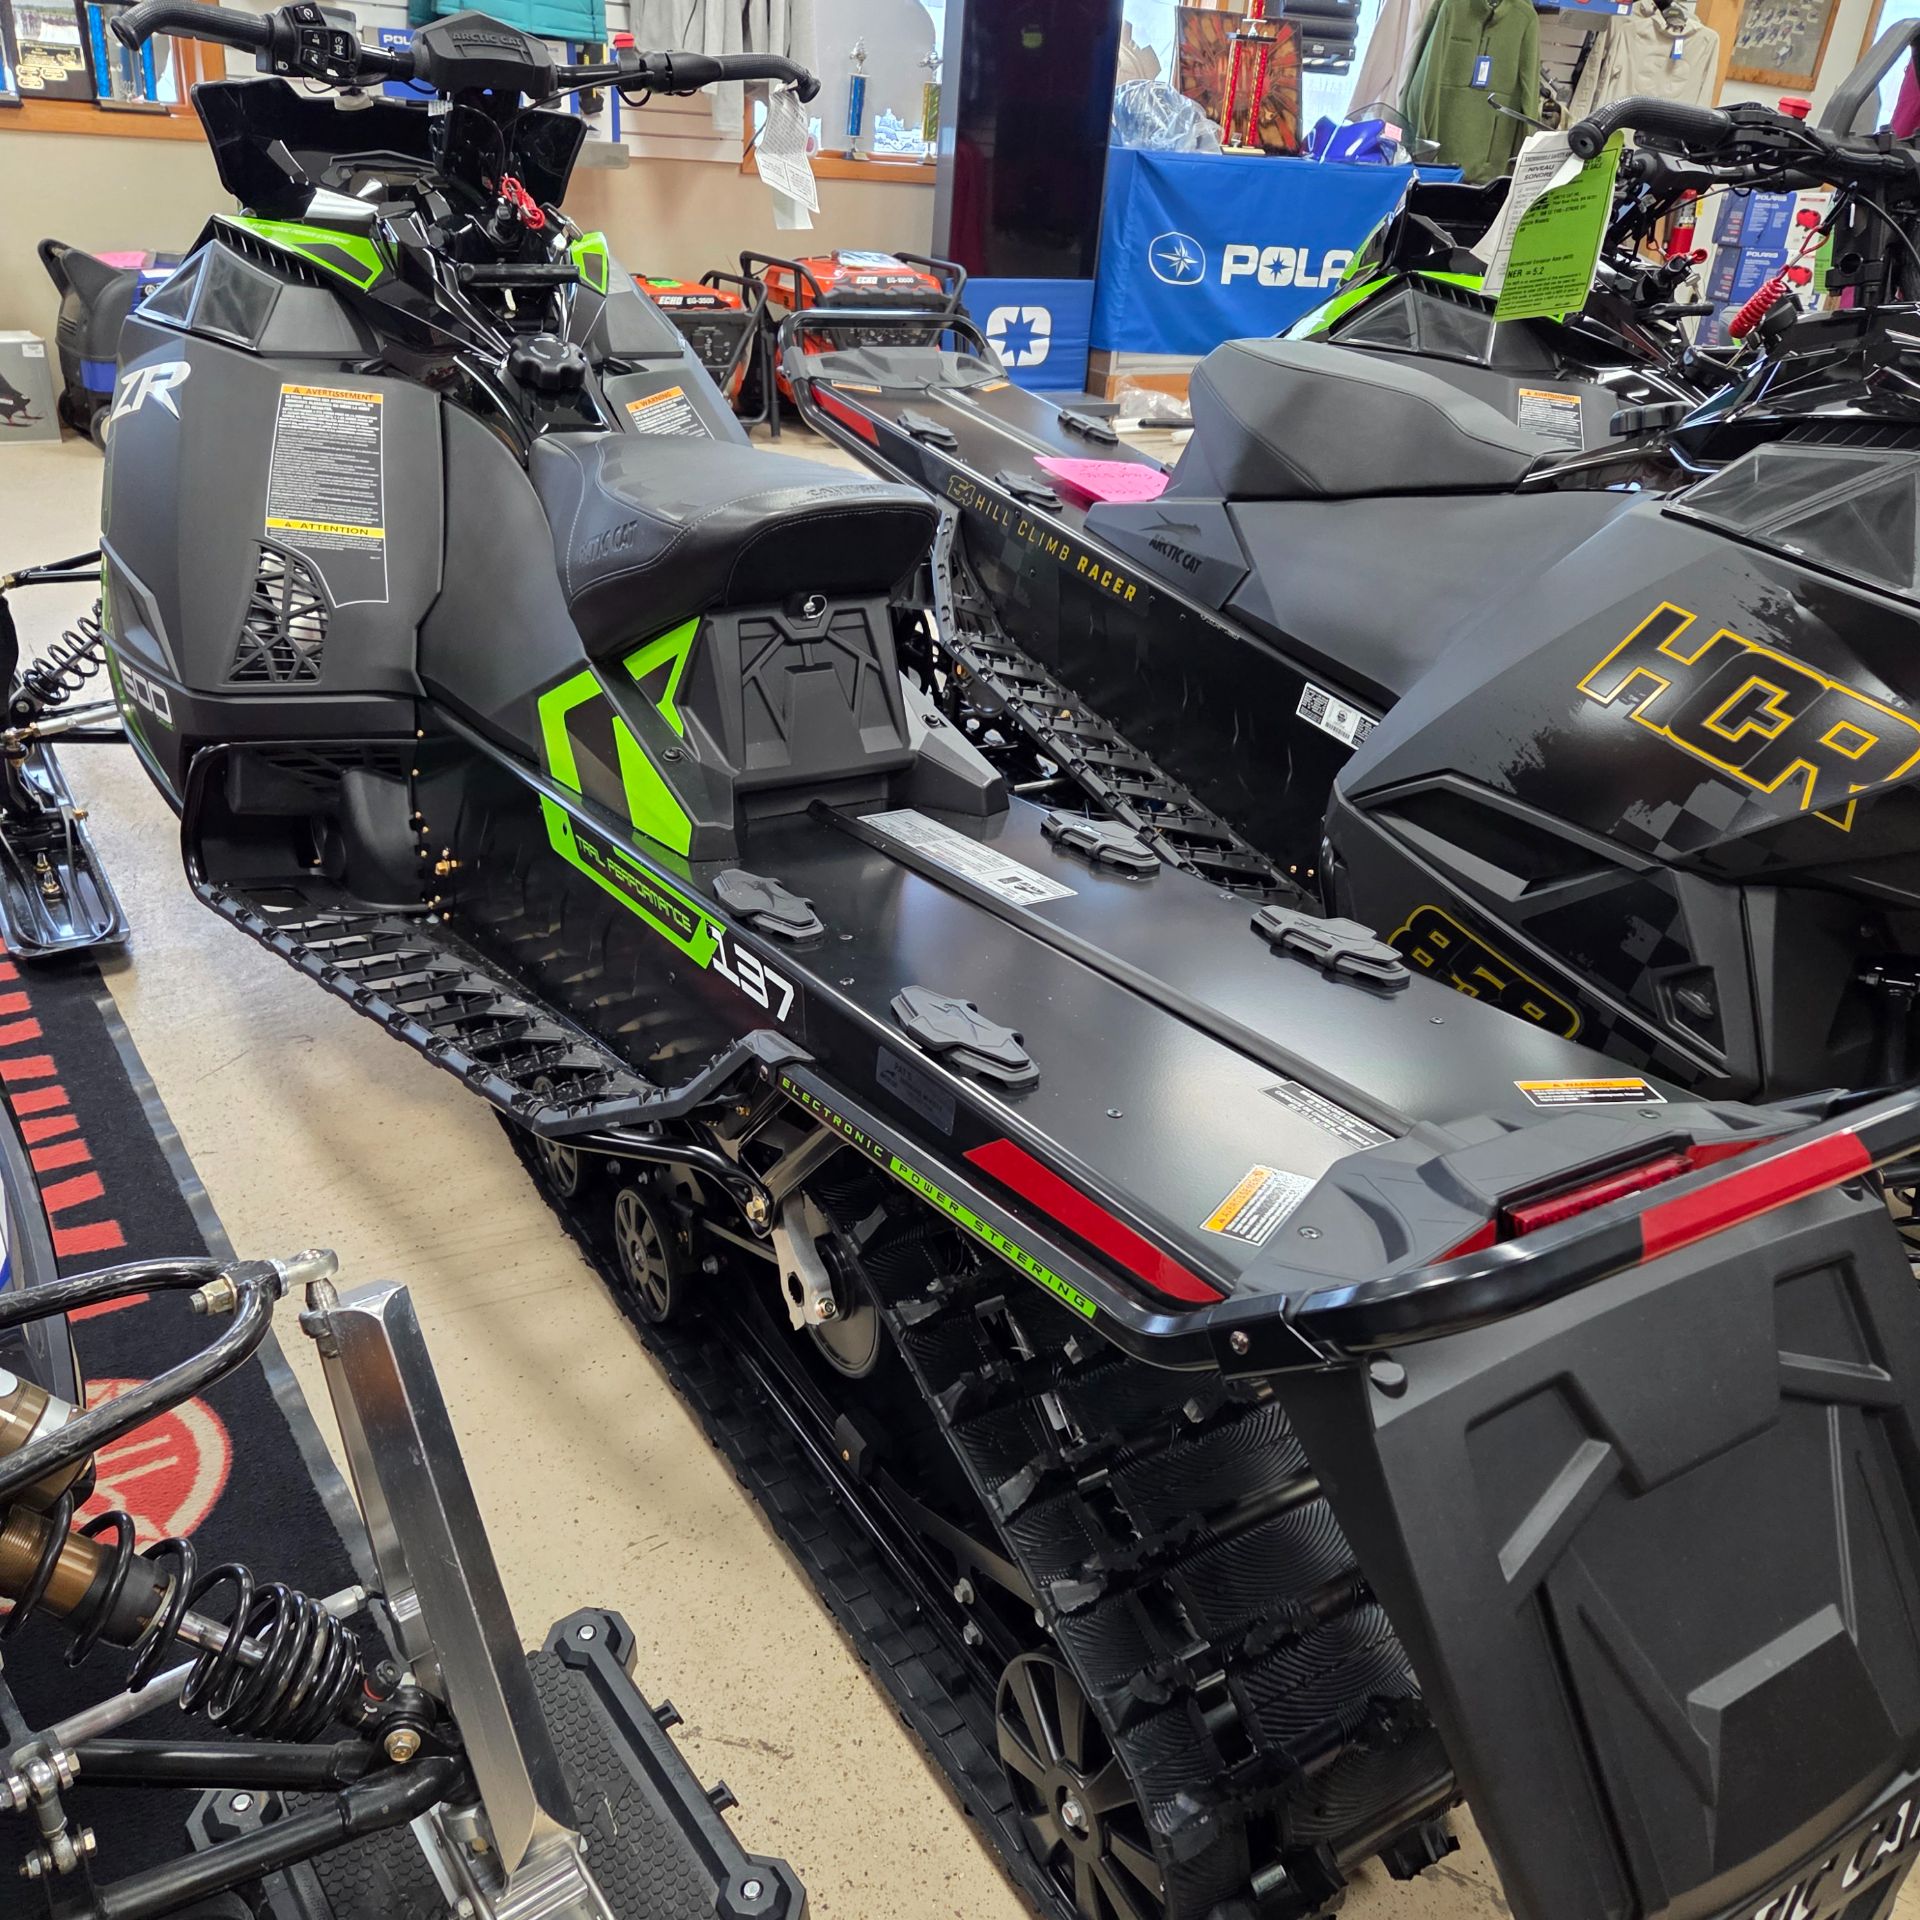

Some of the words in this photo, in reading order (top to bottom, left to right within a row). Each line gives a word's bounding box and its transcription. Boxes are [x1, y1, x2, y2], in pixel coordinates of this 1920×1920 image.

[452, 32, 498, 43] ARCTIC
[500, 35, 522, 47] CAT
[1528, 164, 1555, 172] NIVEAU
[1524, 172, 1554, 180] SONORE
[1755, 194, 1788, 202] POLARIS
[1746, 250, 1779, 259] POLARIS
[1220, 244, 1355, 288] POLA
[1508, 268, 1523, 278] NER
[1532, 266, 1545, 276] 5.2
[856, 276, 878, 284] ECHO
[658, 296, 683, 305] ECHO
[110, 361, 191, 421] ZR
[306, 388, 374, 401] AVERTISSEMENT
[640, 391, 673, 407] WARNING
[300, 523, 369, 535] ATTENTION
[974, 494, 1008, 526] HILL
[1017, 520, 1070, 561] CLIMB
[1077, 555, 1137, 602] RACER
[1148, 538, 1185, 564] ARCTIC
[1182, 553, 1203, 574] CAT
[1576, 601, 1920, 832] HCR
[575, 834, 606, 867] TRAIL
[606, 857, 692, 935] PERFORMANCE
[710, 924, 795, 1022] 137
[782, 1077, 884, 1158] ELECTRONIC
[899, 1163, 959, 1213] POWER
[974, 1219, 1086, 1309] STEERING
